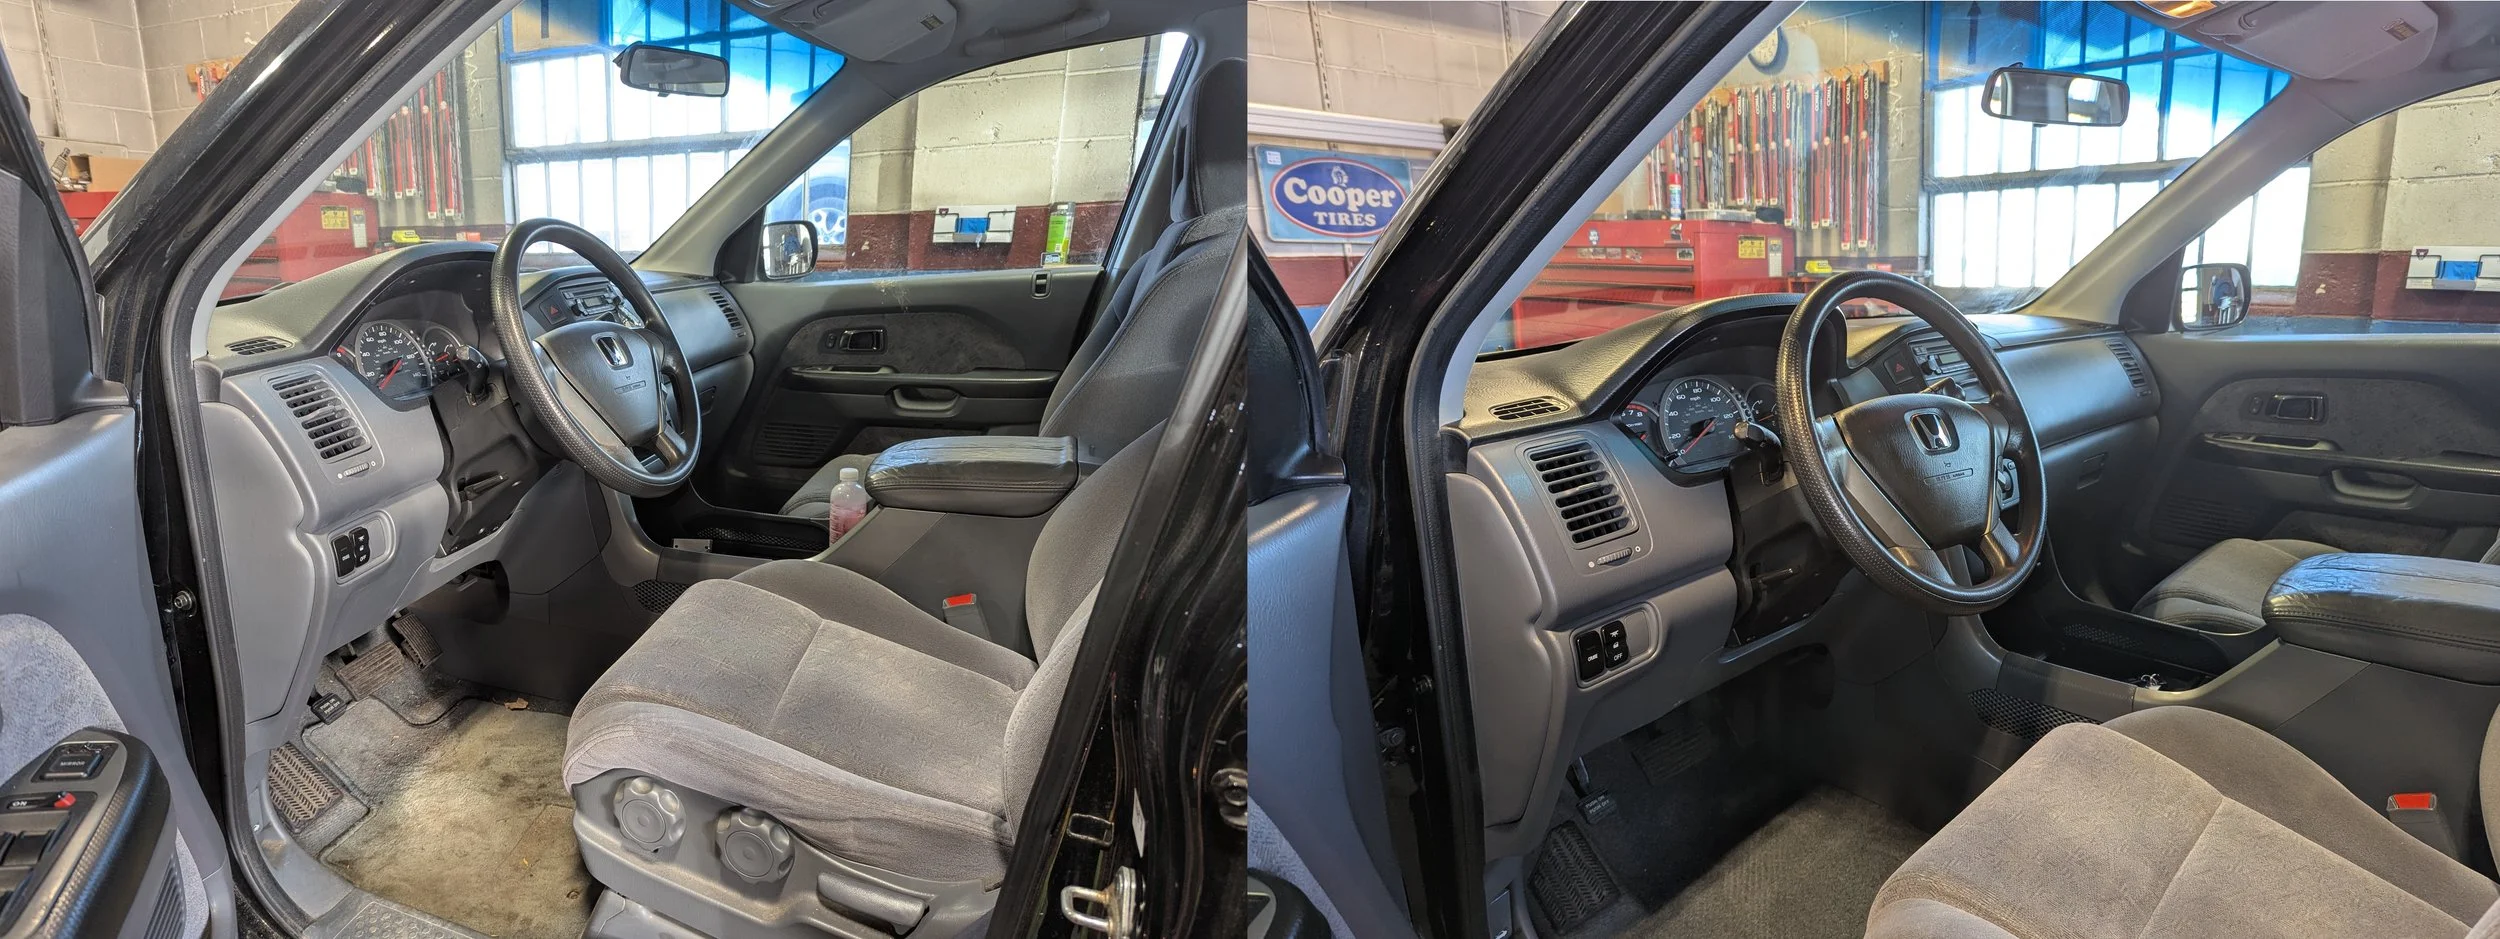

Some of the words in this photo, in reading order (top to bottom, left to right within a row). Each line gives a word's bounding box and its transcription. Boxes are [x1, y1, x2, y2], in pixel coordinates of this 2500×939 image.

[1283, 176, 1396, 212] Cooper
[1313, 211, 1377, 227] TIRES
[1614, 652, 1623, 661] OFF
